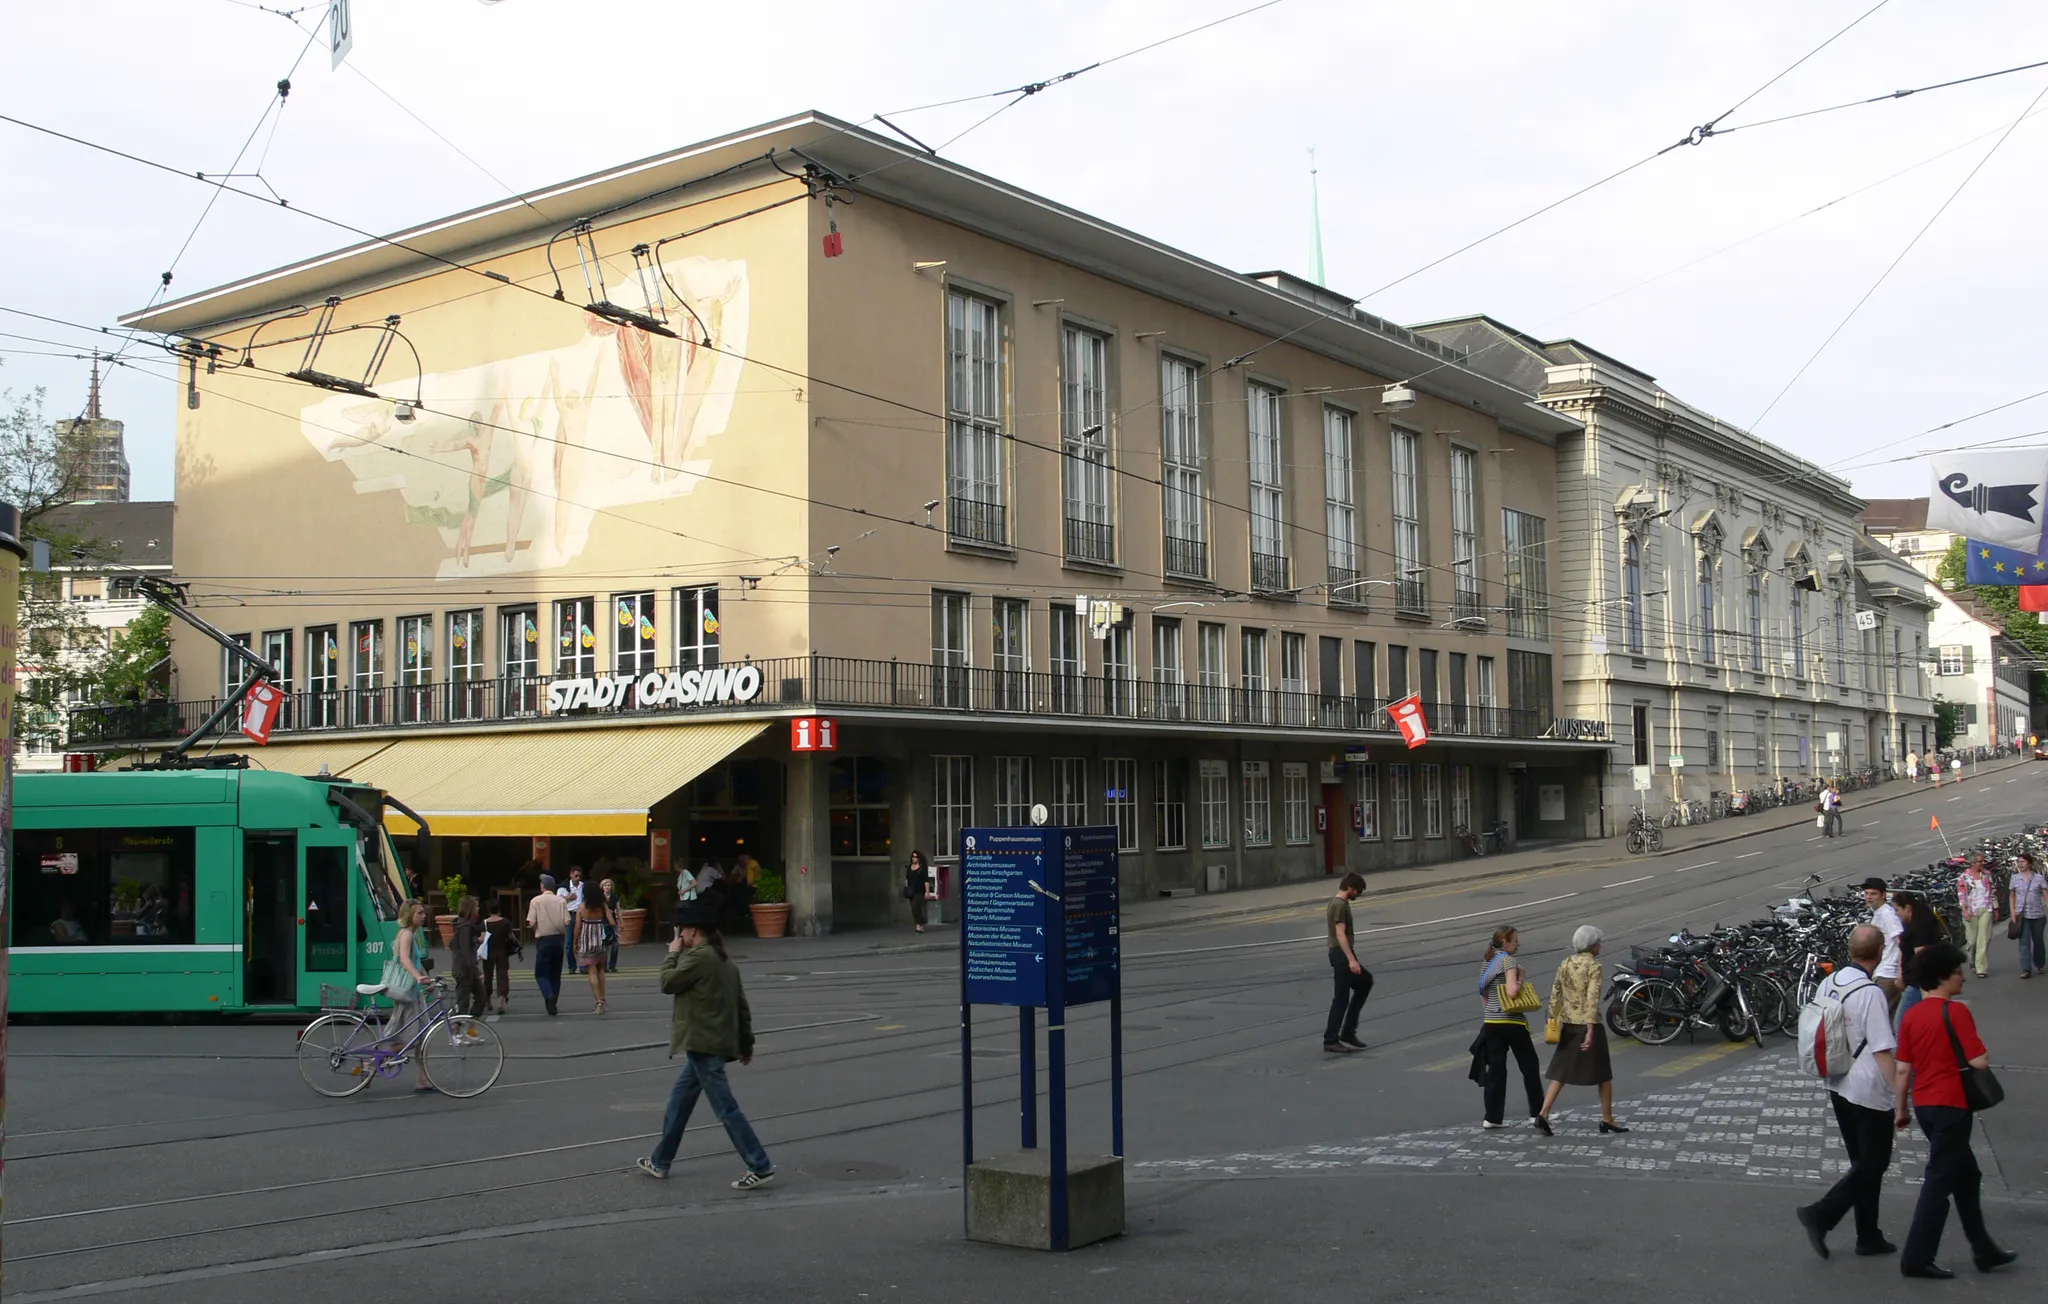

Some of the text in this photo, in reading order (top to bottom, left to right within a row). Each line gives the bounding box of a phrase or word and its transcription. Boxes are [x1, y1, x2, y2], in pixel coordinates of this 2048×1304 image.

[332, 0, 348, 54] 20
[1859, 614, 1873, 626] 45
[546, 666, 761, 711] STADT CASINO
[56, 836, 63, 849] 8
[992, 870, 1024, 878] Kirschgarten
[993, 900, 1035, 908] Gegenwartskunst
[967, 925, 999, 933] Historisches
[366, 941, 384, 954] 307
[968, 940, 1012, 948] Naturhistorisches
[969, 951, 1007, 959] Musikmuseum
[968, 959, 1017, 967] Pharmaziemuseum
